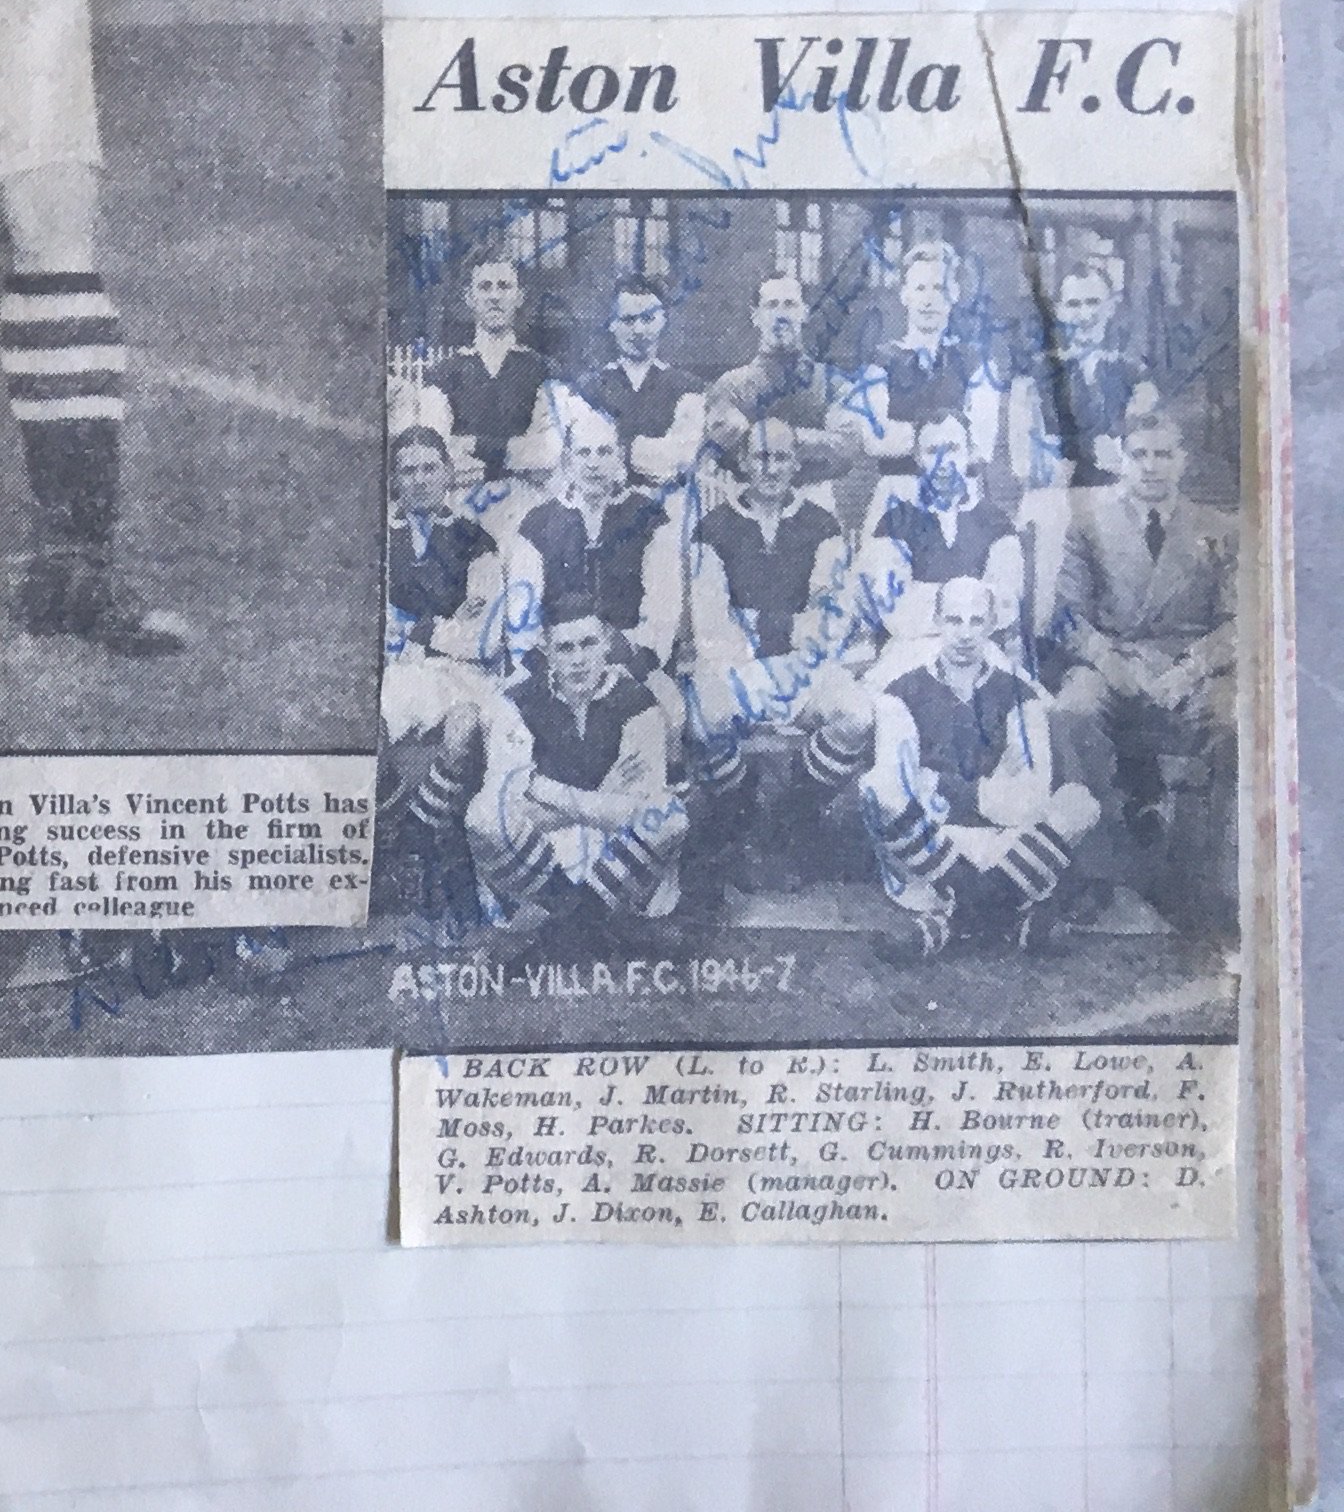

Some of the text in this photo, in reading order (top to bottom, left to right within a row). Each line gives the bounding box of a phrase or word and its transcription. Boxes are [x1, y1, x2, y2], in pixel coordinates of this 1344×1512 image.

[413, 35, 1198, 115] Aston Villa F.C.
[27, 792, 111, 817] Villa's
[123, 792, 229, 816] Vincent
[241, 791, 311, 815] Potts
[322, 791, 370, 814] has
[46, 823, 142, 841] success
[160, 819, 186, 840] in
[206, 818, 250, 840] the
[266, 817, 323, 839] firm
[341, 817, 372, 840] of
[87, 844, 211, 866] defensive
[227, 842, 370, 870] specialists.
[49, 870, 100, 892] fast
[115, 870, 178, 892] from
[194, 869, 234, 891] his
[248, 872, 315, 891] more
[328, 872, 370, 891] ex-
[463, 1057, 550, 1079] BACK
[576, 1055, 649, 1078] ROW
[675, 1055, 714, 1076] (L.
[738, 1056, 764, 1075] to
[866, 1052, 894, 1073] L.
[912, 1052, 1003, 1075] Smith,
[1021, 1050, 1052, 1072] E.
[1074, 1050, 1154, 1074] Lowe,
[1176, 1050, 1204, 1071] A.
[436, 1087, 582, 1111] Wakeman,
[599, 1086, 623, 1106] J.
[644, 1085, 748, 1109] Martin,
[766, 1084, 797, 1105] R.
[815, 1082, 935, 1106] Starling,
[952, 1081, 975, 1103] J.
[1177, 1079, 1206, 1101] F.
[437, 1118, 514, 1142] Moss,
[533, 1116, 566, 1137] H.
[589, 1114, 694, 1137] Parkes.
[736, 1112, 883, 1135] SITTING:
[910, 1111, 940, 1132] H.
[960, 1110, 1061, 1131] Bourne
[437, 1148, 466, 1169] G.
[484, 1145, 614, 1169] Edwards,
[636, 1144, 666, 1164] R.
[685, 1143, 798, 1167] Dorsett,
[818, 1141, 848, 1163] G.
[437, 1174, 463, 1195] V.
[481, 1173, 563, 1196] Potts,
[580, 1172, 611, 1194] A.
[630, 1172, 726, 1194] Massie
[934, 1168, 980, 1190] ON
[998, 1167, 1150, 1189] GROUND:
[1175, 1165, 1206, 1188] D.
[433, 1198, 889, 1228] Ashton, J. Dixon, E. Callaghan.
